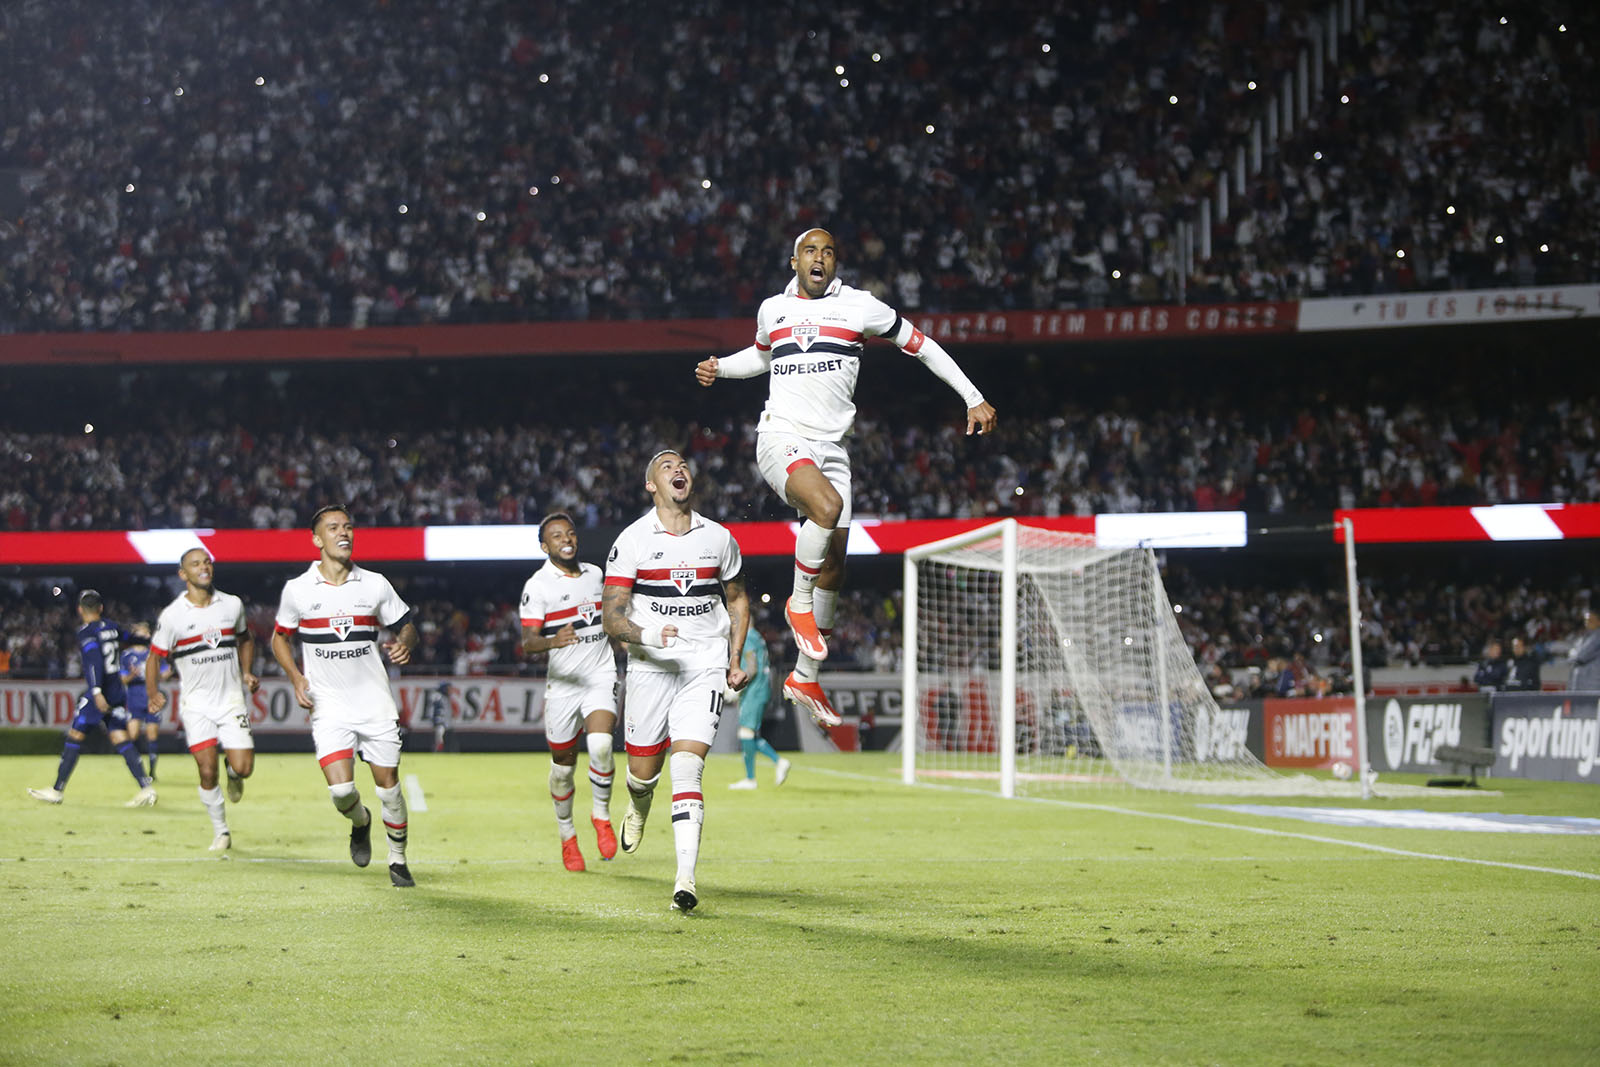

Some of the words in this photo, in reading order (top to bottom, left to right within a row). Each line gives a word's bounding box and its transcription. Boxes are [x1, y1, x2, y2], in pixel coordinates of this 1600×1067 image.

[1033, 314, 1086, 335] TEM
[1104, 307, 1168, 333] TRÊS
[1186, 305, 1277, 330] CORES
[773, 359, 843, 375] SUPERBET
[672, 570, 695, 579] SPFC
[0, 690, 76, 725] UND
[825, 689, 903, 716] PFC
[1284, 712, 1353, 759] MAPFRE
